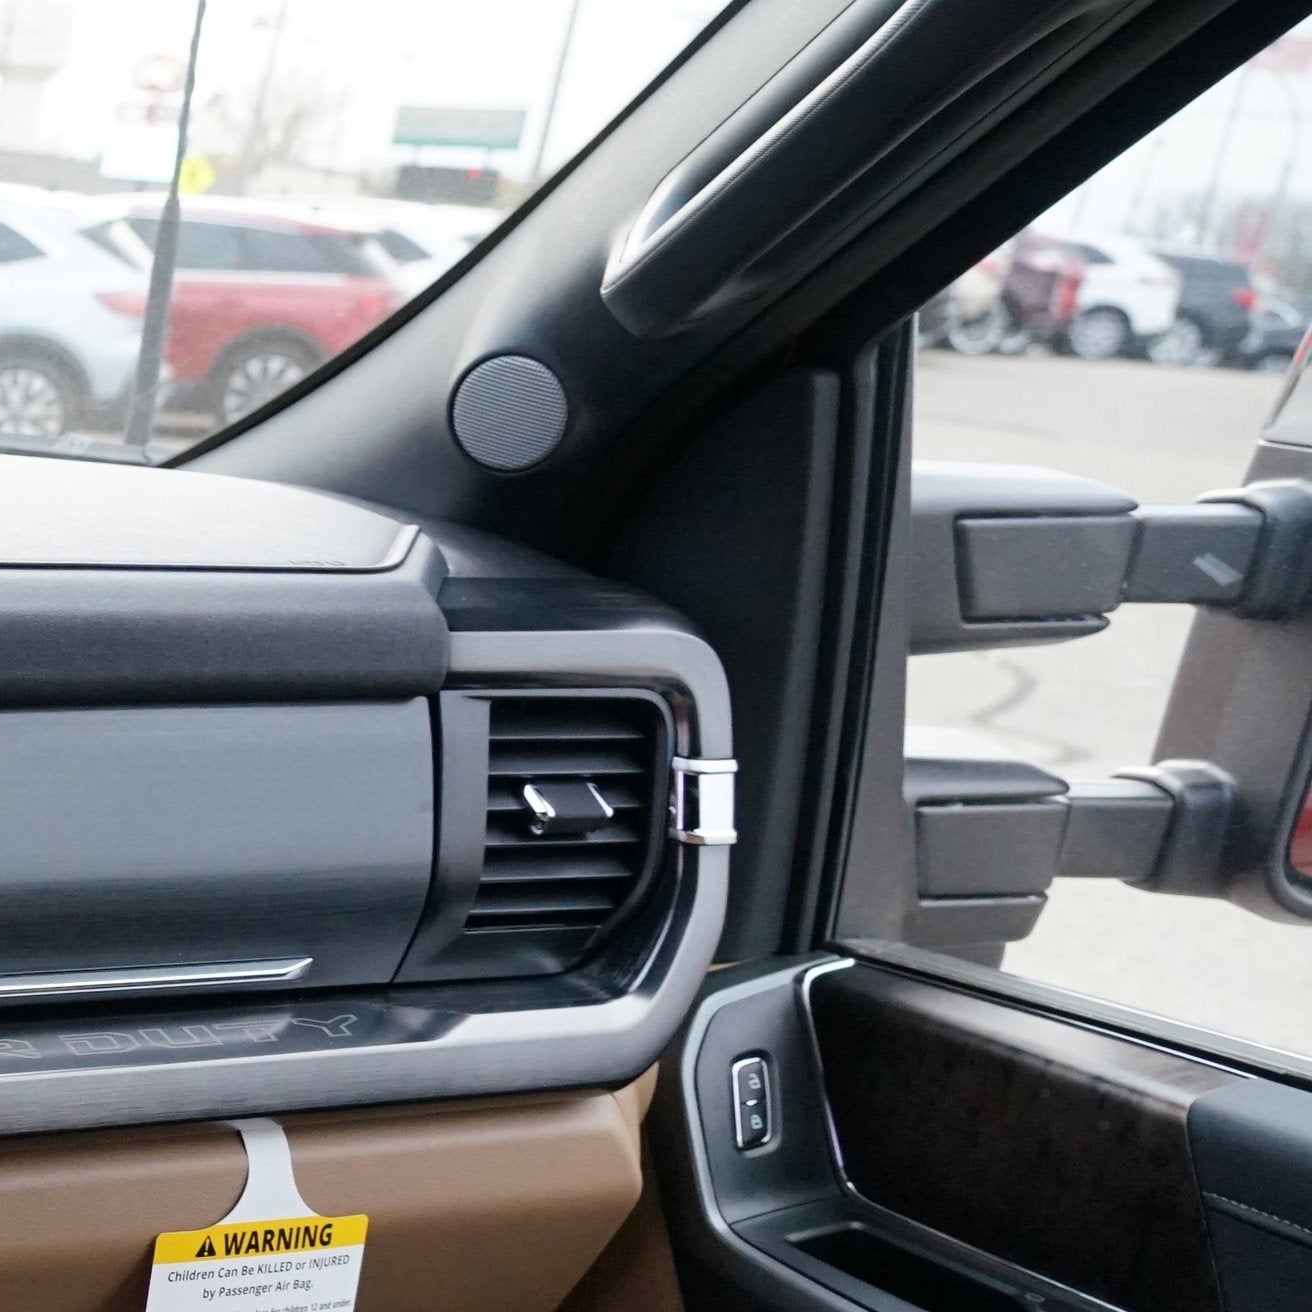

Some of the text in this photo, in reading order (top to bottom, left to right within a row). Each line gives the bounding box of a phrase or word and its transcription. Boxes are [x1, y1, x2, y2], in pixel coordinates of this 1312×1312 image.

[57, 1014, 358, 1057] DUTY
[223, 1222, 333, 1256] WARNING
[167, 1254, 350, 1283] Children Can Be KILLED or INJURED
[202, 1279, 314, 1301] by Passenger Air Bag.
[319, 1301, 331, 1311] and
